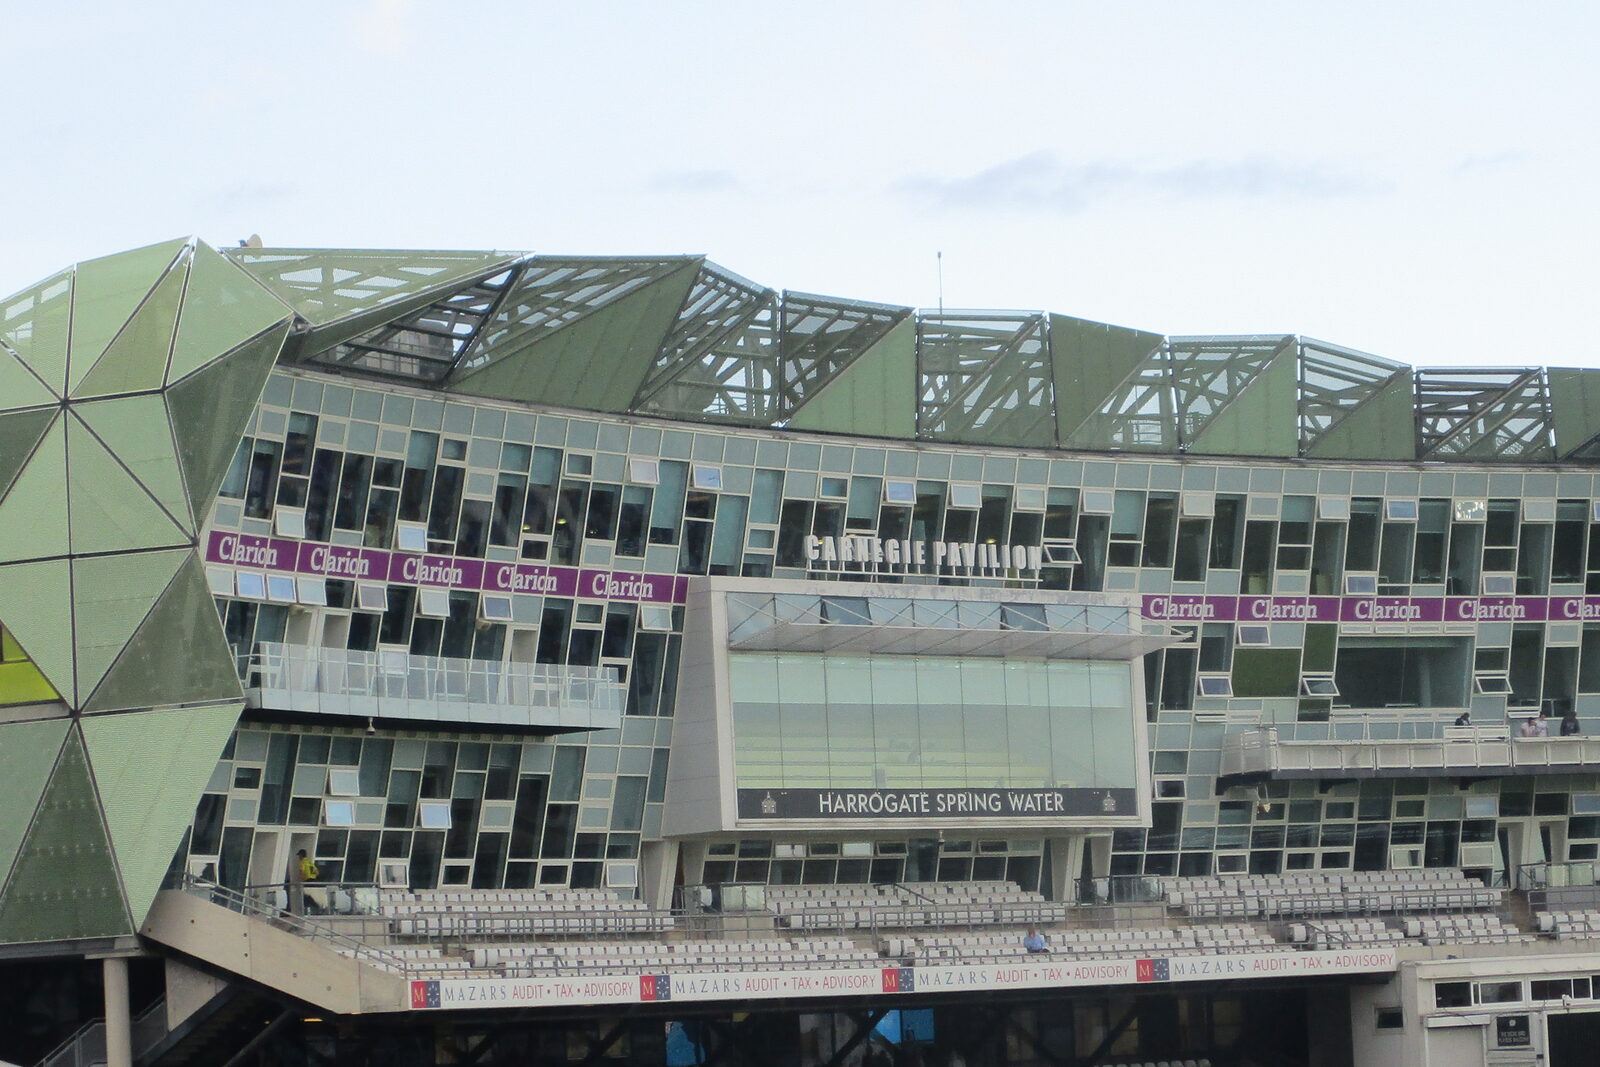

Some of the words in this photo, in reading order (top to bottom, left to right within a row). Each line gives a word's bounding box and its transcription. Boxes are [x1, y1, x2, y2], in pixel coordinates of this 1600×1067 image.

[218, 535, 277, 567] Clarion
[310, 547, 369, 576] Clarion
[804, 534, 926, 565] CARNEGIE
[932, 541, 1042, 570] PAVILION
[403, 556, 462, 585] Clarion
[497, 565, 557, 592] Clarion
[592, 573, 653, 599] Clarion
[1149, 598, 1214, 618] Clarion
[1251, 599, 1318, 619] Clarion
[1354, 599, 1421, 619] Clarion
[1458, 599, 1526, 619] Clarion
[819, 792, 930, 814] HARROGATE
[936, 792, 1001, 813] SPRING
[1008, 791, 1065, 813] WATER
[918, 970, 989, 986] MAZARS
[995, 968, 1031, 984] AUDIT
[1041, 967, 1063, 982] TAX
[1073, 964, 1131, 980] ADVISORY
[1173, 959, 1246, 976] MAZARS
[1253, 957, 1290, 973] AUDIT
[1300, 956, 1323, 970] TAX
[1334, 952, 1394, 968] ADVISORY
[444, 984, 507, 1001] MAZARS
[512, 982, 545, 999] AUDIT
[554, 982, 575, 998] TAX
[584, 980, 634, 997] ADVISORY
[675, 977, 741, 994] MAZARS
[745, 976, 781, 992] AUDIT
[790, 976, 813, 991] TAX
[822, 973, 876, 990] ADVISORY
